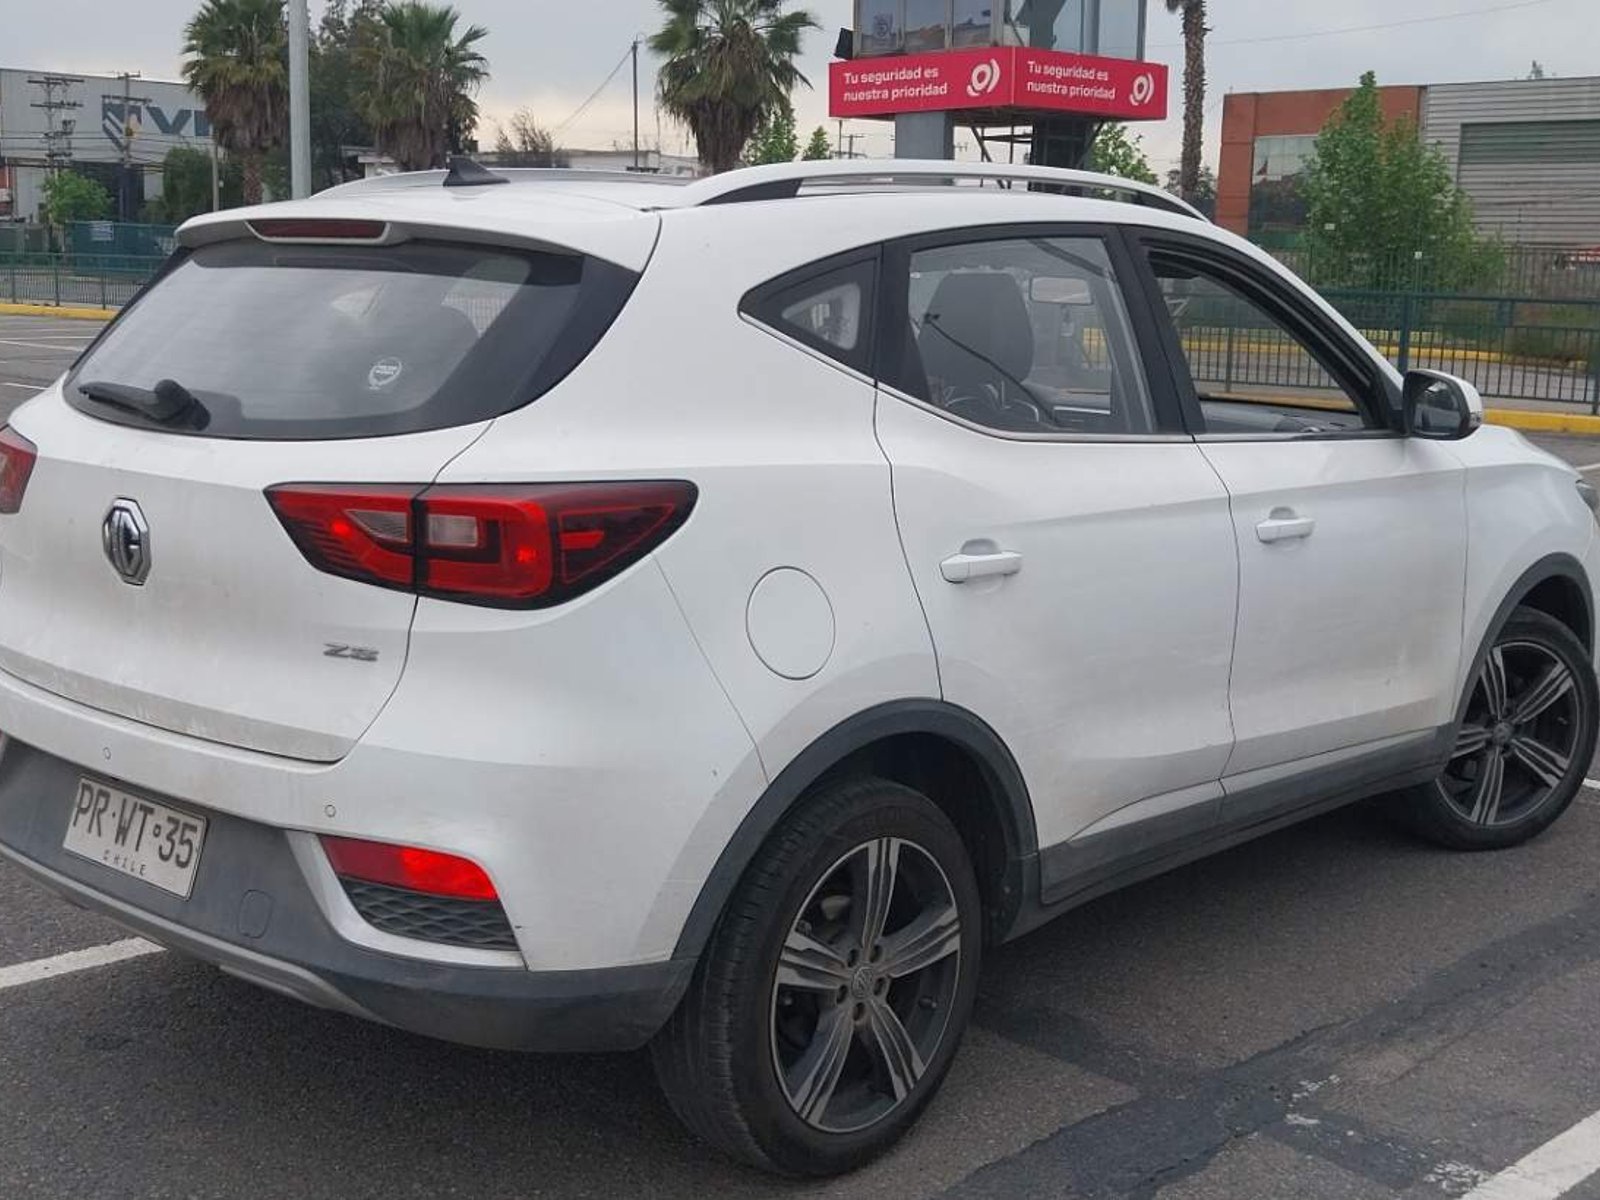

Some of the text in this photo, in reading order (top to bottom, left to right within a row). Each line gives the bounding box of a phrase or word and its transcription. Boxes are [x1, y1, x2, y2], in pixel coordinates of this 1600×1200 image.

[844, 67, 939, 84] Tu seguridad es
[1027, 61, 1109, 81] Tu seguridad es
[843, 82, 948, 101] nuestra prioridad
[1027, 80, 1116, 99] nuestra prioridad
[102, 849, 147, 877] CHILE
